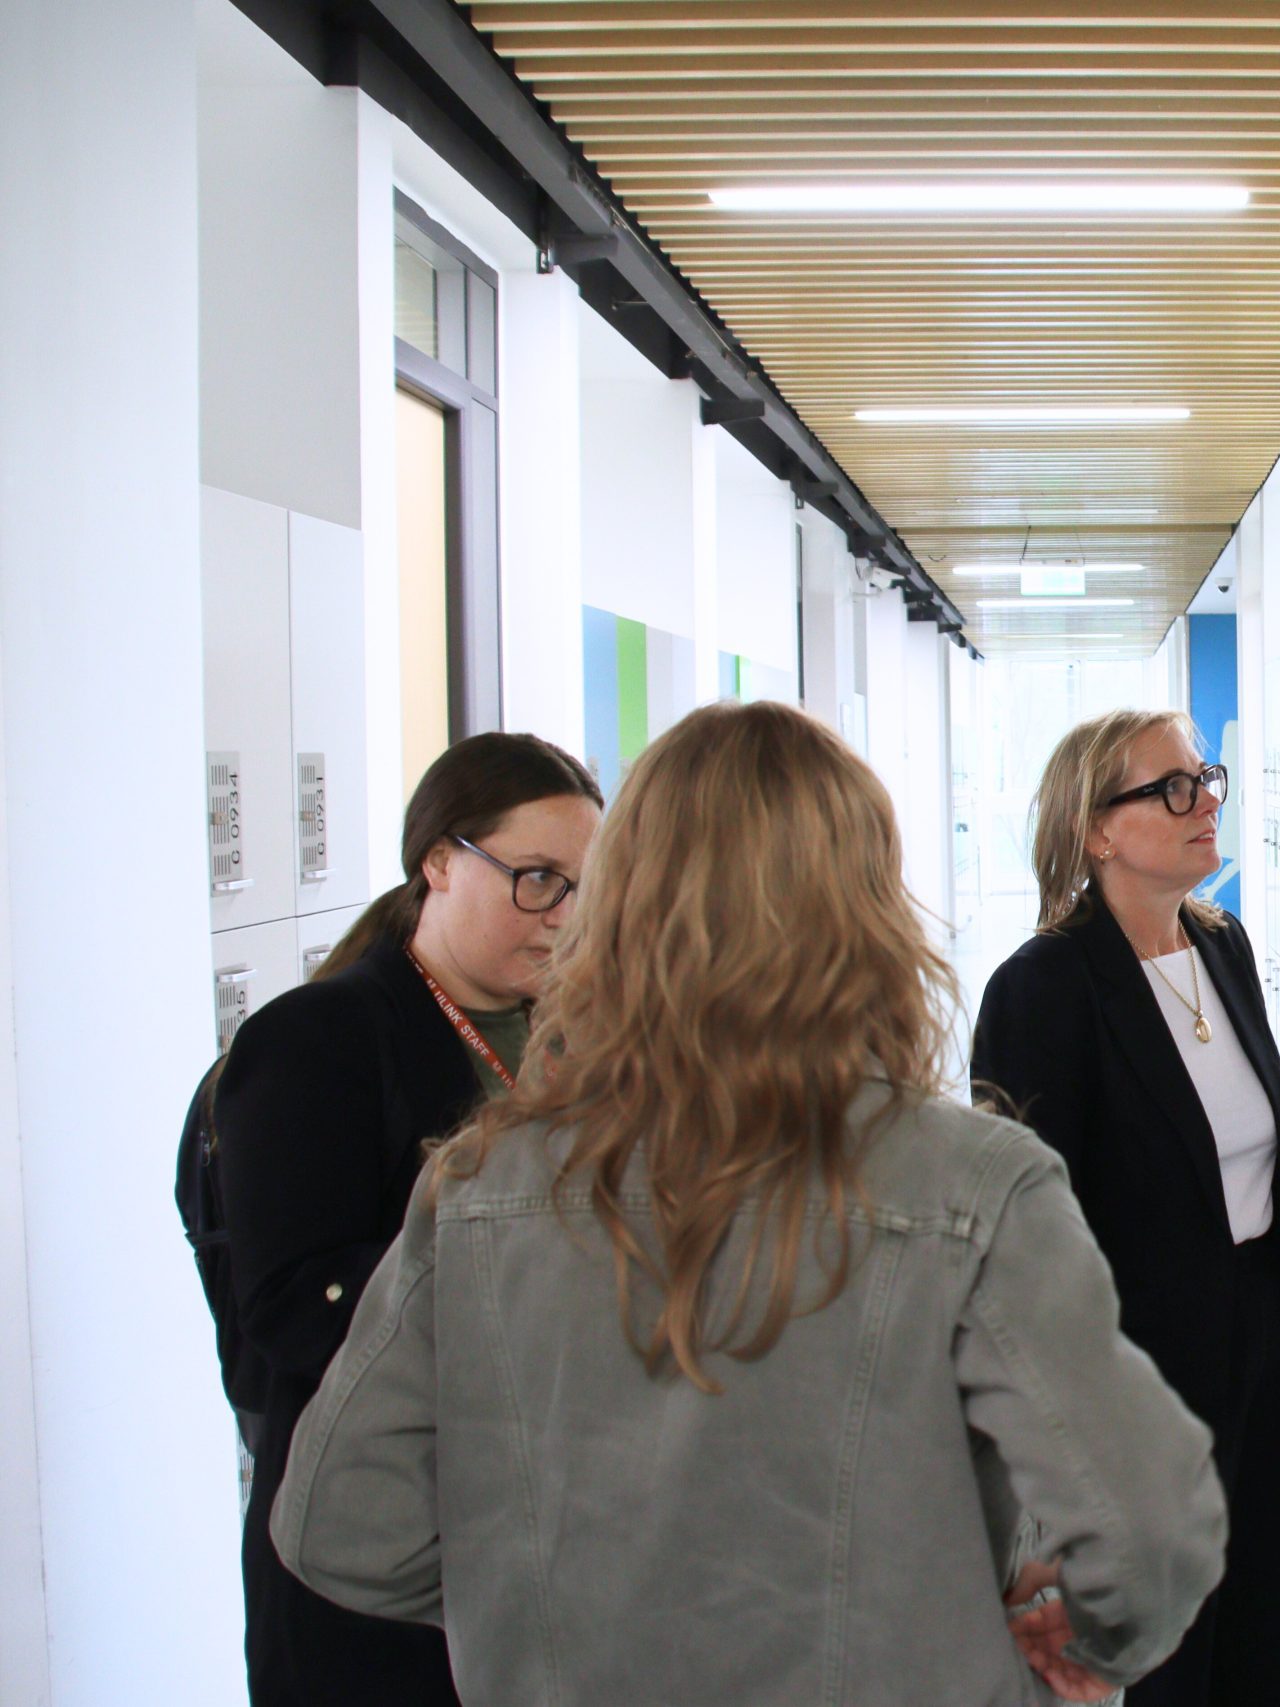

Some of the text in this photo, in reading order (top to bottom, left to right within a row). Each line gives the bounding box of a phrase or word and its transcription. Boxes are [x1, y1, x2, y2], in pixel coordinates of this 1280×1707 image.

[229, 772, 241, 865] C 0934
[316, 776, 325, 855] C 0931
[237, 990, 247, 1023] 35
[434, 990, 490, 1057] ULINK STAFF
